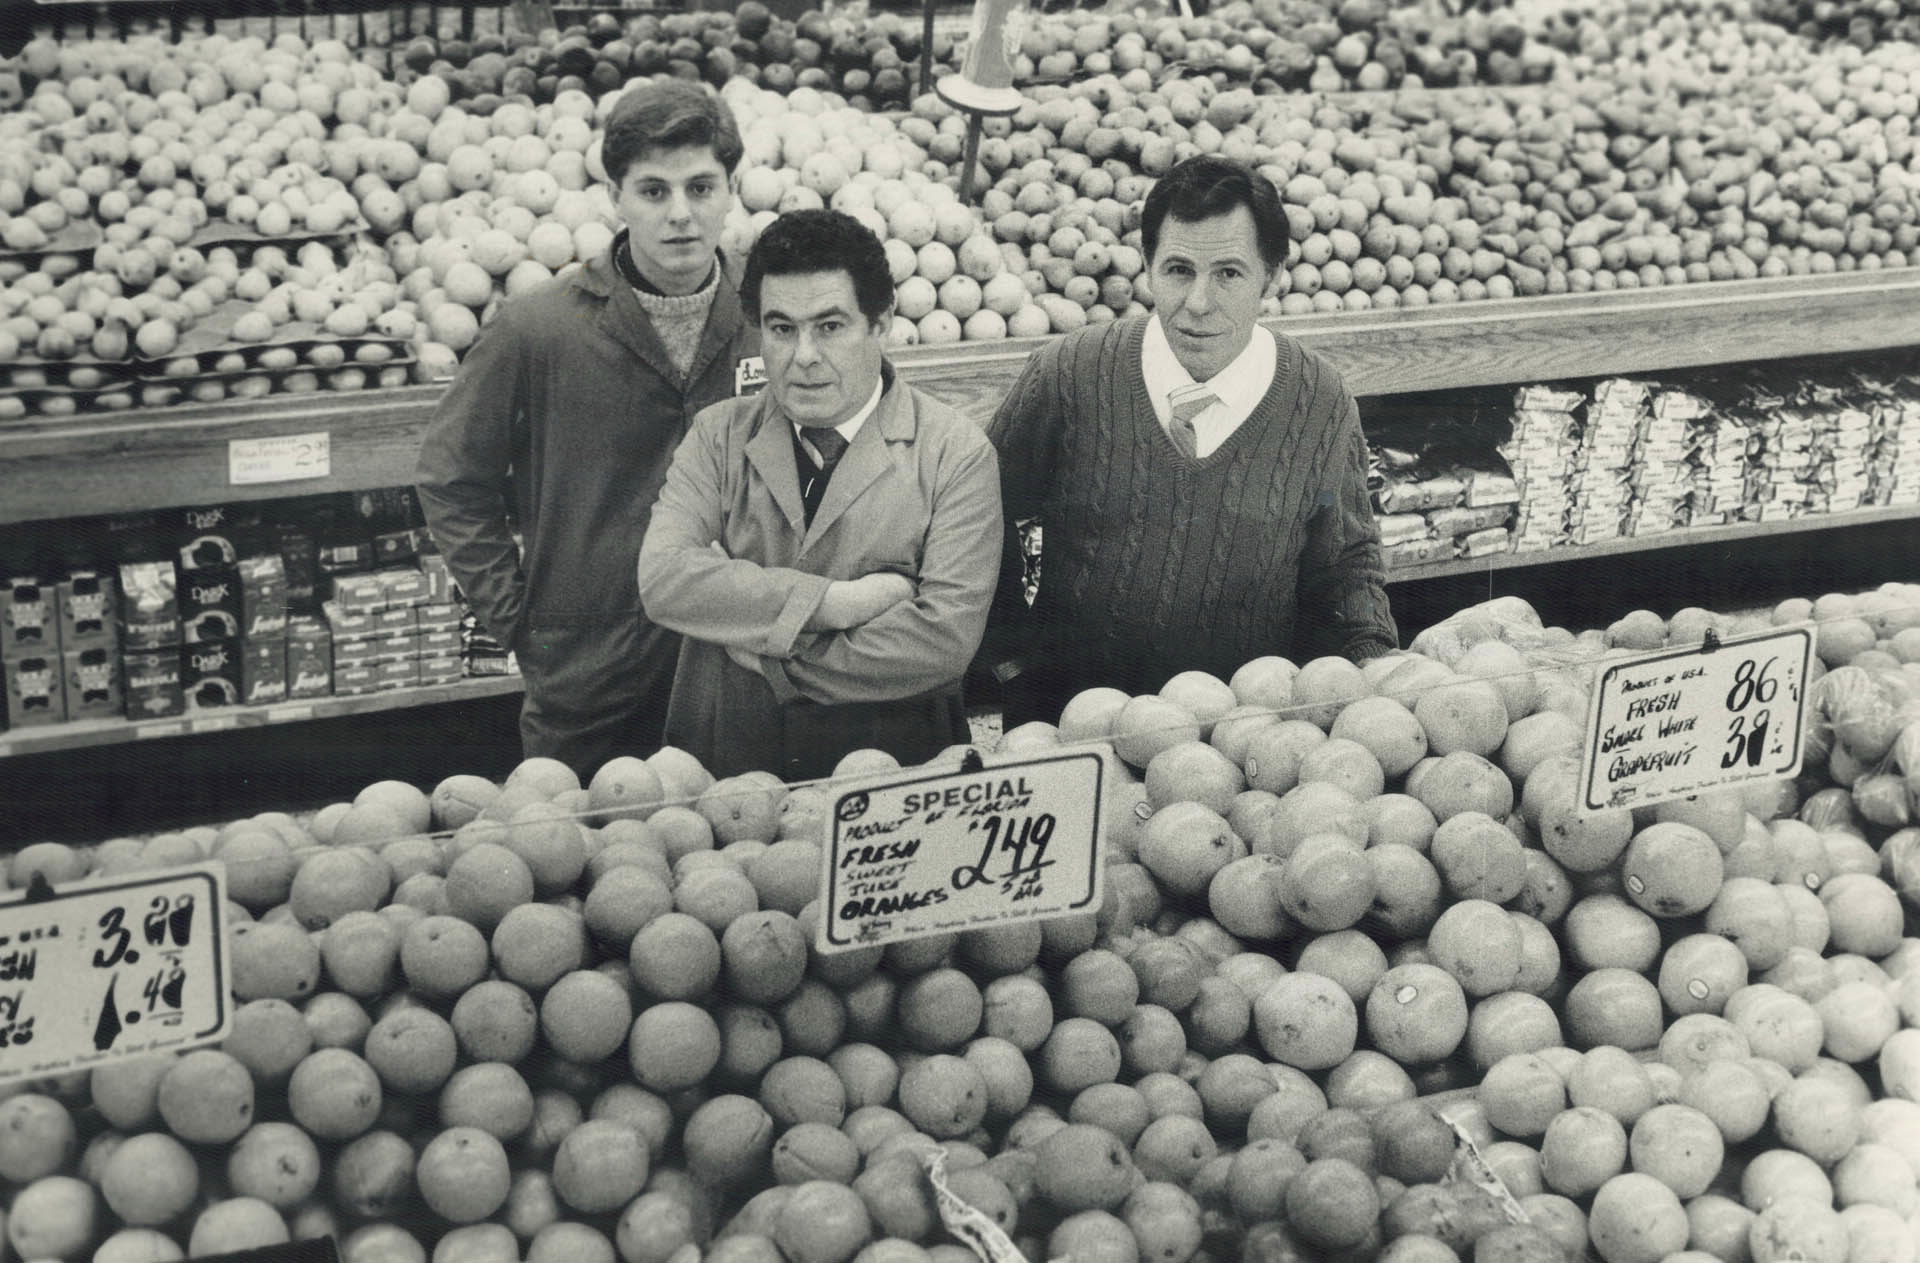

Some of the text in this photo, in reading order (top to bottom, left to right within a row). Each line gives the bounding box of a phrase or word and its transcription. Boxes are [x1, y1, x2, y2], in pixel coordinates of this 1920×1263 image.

[1726, 655, 1779, 712] 86
[1626, 690, 1682, 721] FRESH
[1658, 715, 1698, 739] WHITE
[1608, 745, 1698, 783] GRAPEFRUIT
[903, 777, 1034, 815] SPECIAL
[840, 839, 921, 869] FRESH
[840, 887, 950, 921] ORANGES
